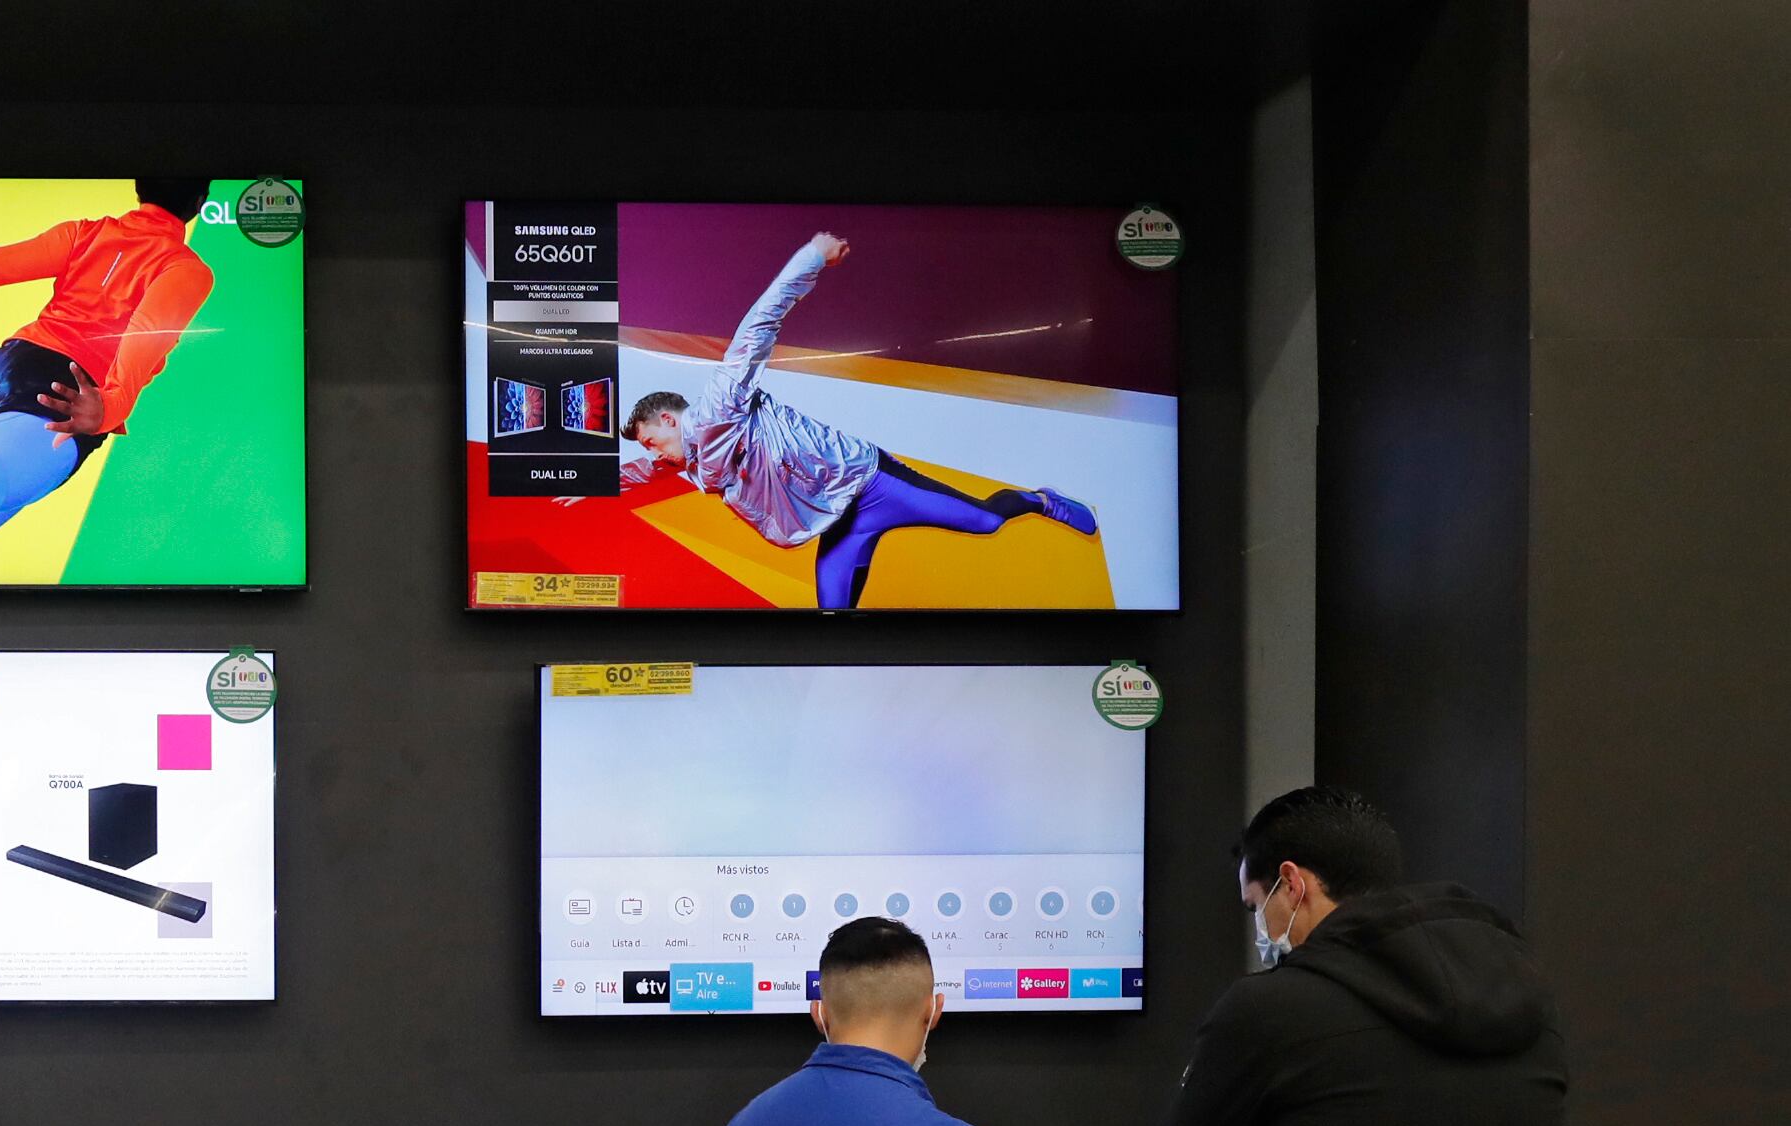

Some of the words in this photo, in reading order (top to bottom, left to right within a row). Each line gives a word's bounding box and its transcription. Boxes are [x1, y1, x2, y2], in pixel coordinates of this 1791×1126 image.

[245, 190, 265, 212] SÍ
[514, 226, 569, 236] SAMSUNG
[571, 226, 596, 237] QLED
[515, 244, 597, 263] 65Q60T
[530, 470, 557, 479] DUAL
[559, 470, 578, 480] LED
[533, 576, 558, 592] 34
[217, 668, 237, 688] SÍ
[605, 666, 633, 683] 60
[1102, 675, 1122, 696] SÍ
[49, 780, 83, 790] Q700A
[717, 865, 738, 875] Más
[740, 865, 770, 875] vistos
[722, 933, 738, 942] RCN
[931, 931, 942, 940] LA
[1035, 930, 1054, 940] RCN
[1055, 930, 1068, 940] HD
[612, 938, 629, 948] Lista
[696, 973, 715, 985] TV
[1033, 979, 1066, 990] Gallery
[648, 981, 667, 995] tv
[773, 980, 801, 992] YouTube
[696, 989, 719, 999] Aire
